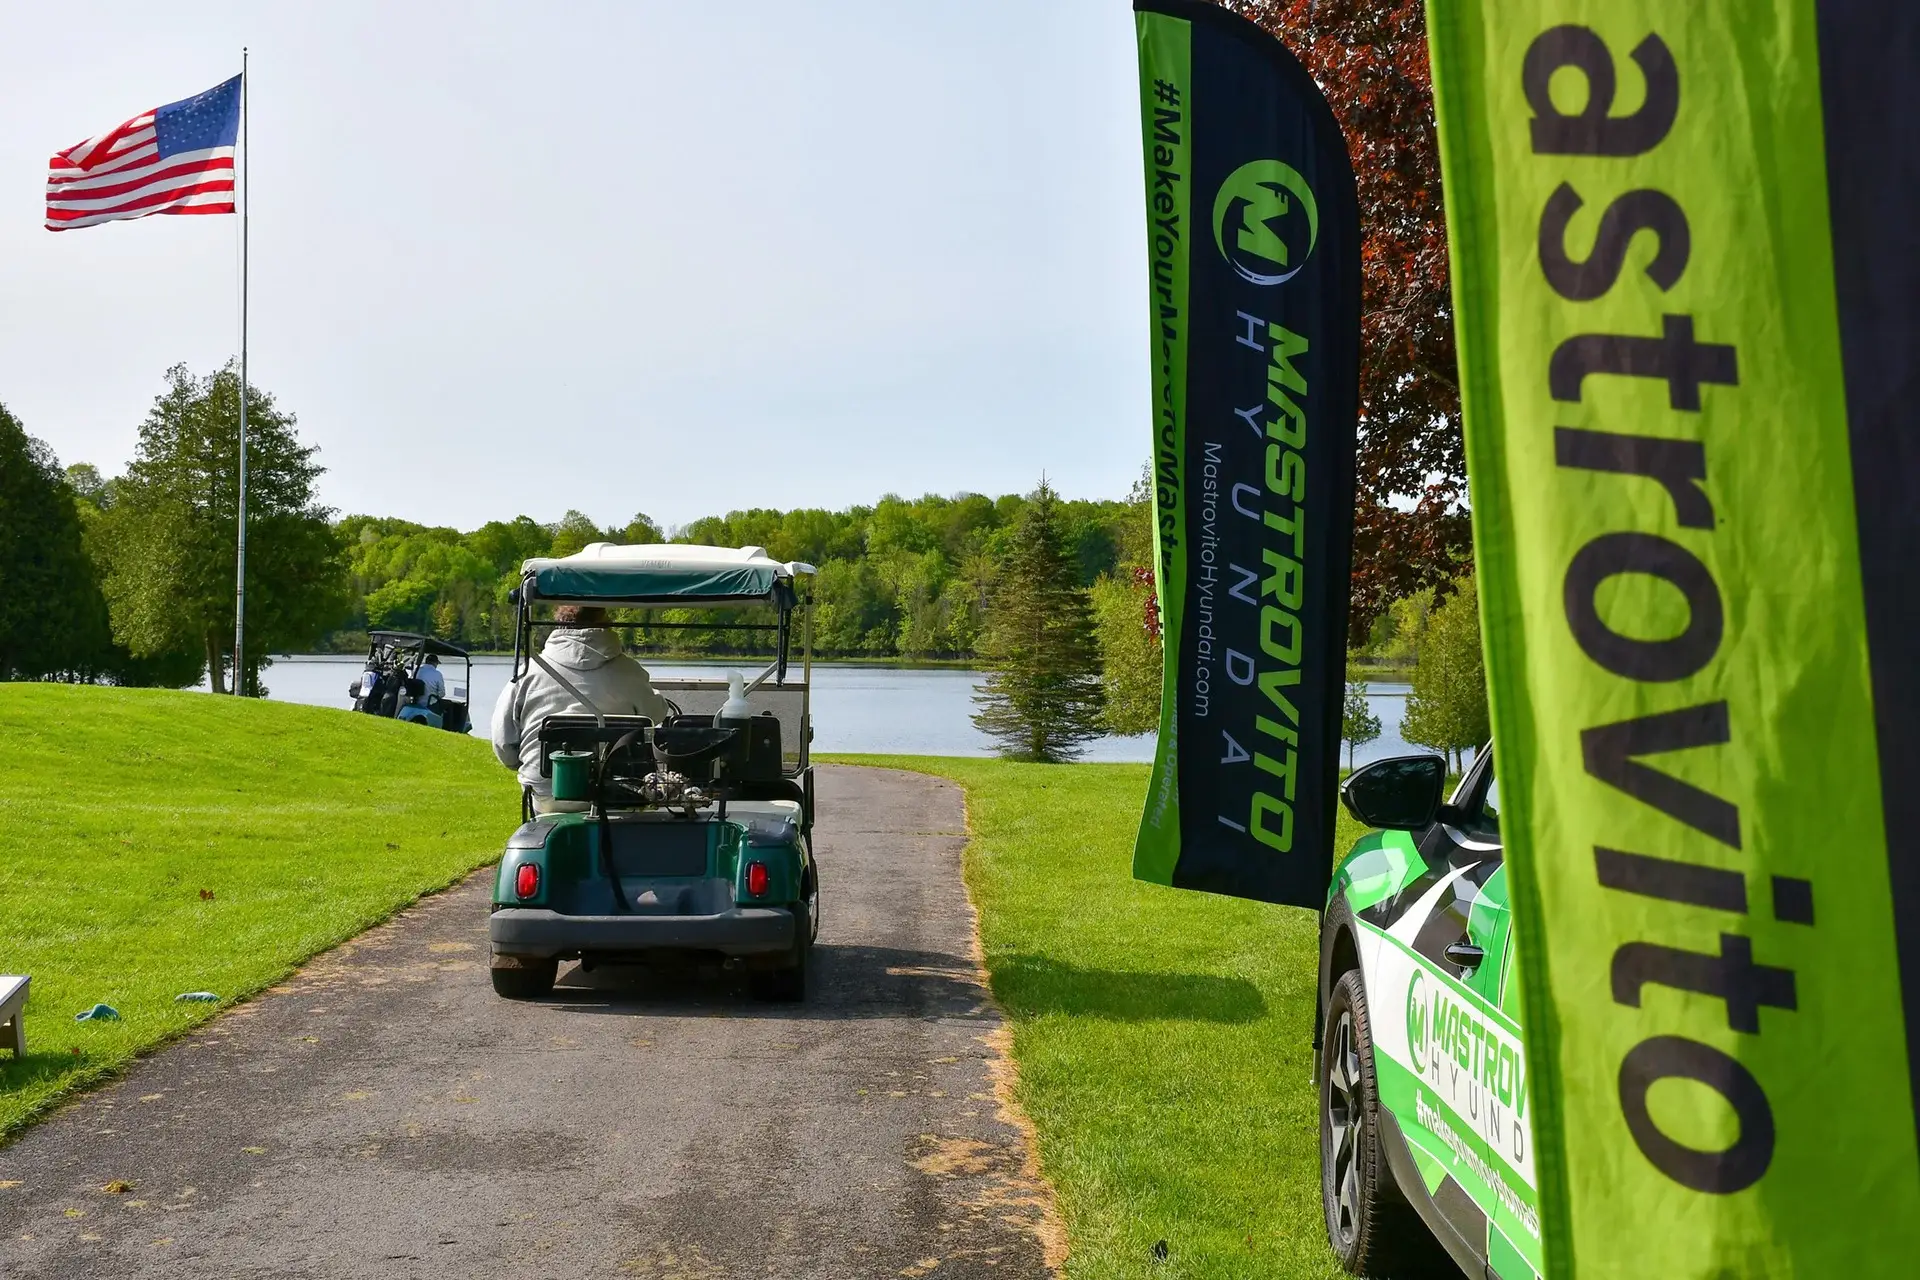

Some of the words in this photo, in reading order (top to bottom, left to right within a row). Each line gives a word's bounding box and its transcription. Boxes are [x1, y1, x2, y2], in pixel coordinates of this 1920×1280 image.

[1195, 441, 1222, 718] MastrovitoHyundai.com
[1217, 309, 1265, 833] HYUNDAI
[1250, 322, 1309, 853] MASTROVITO
[1522, 24, 1815, 1195] astrovito
